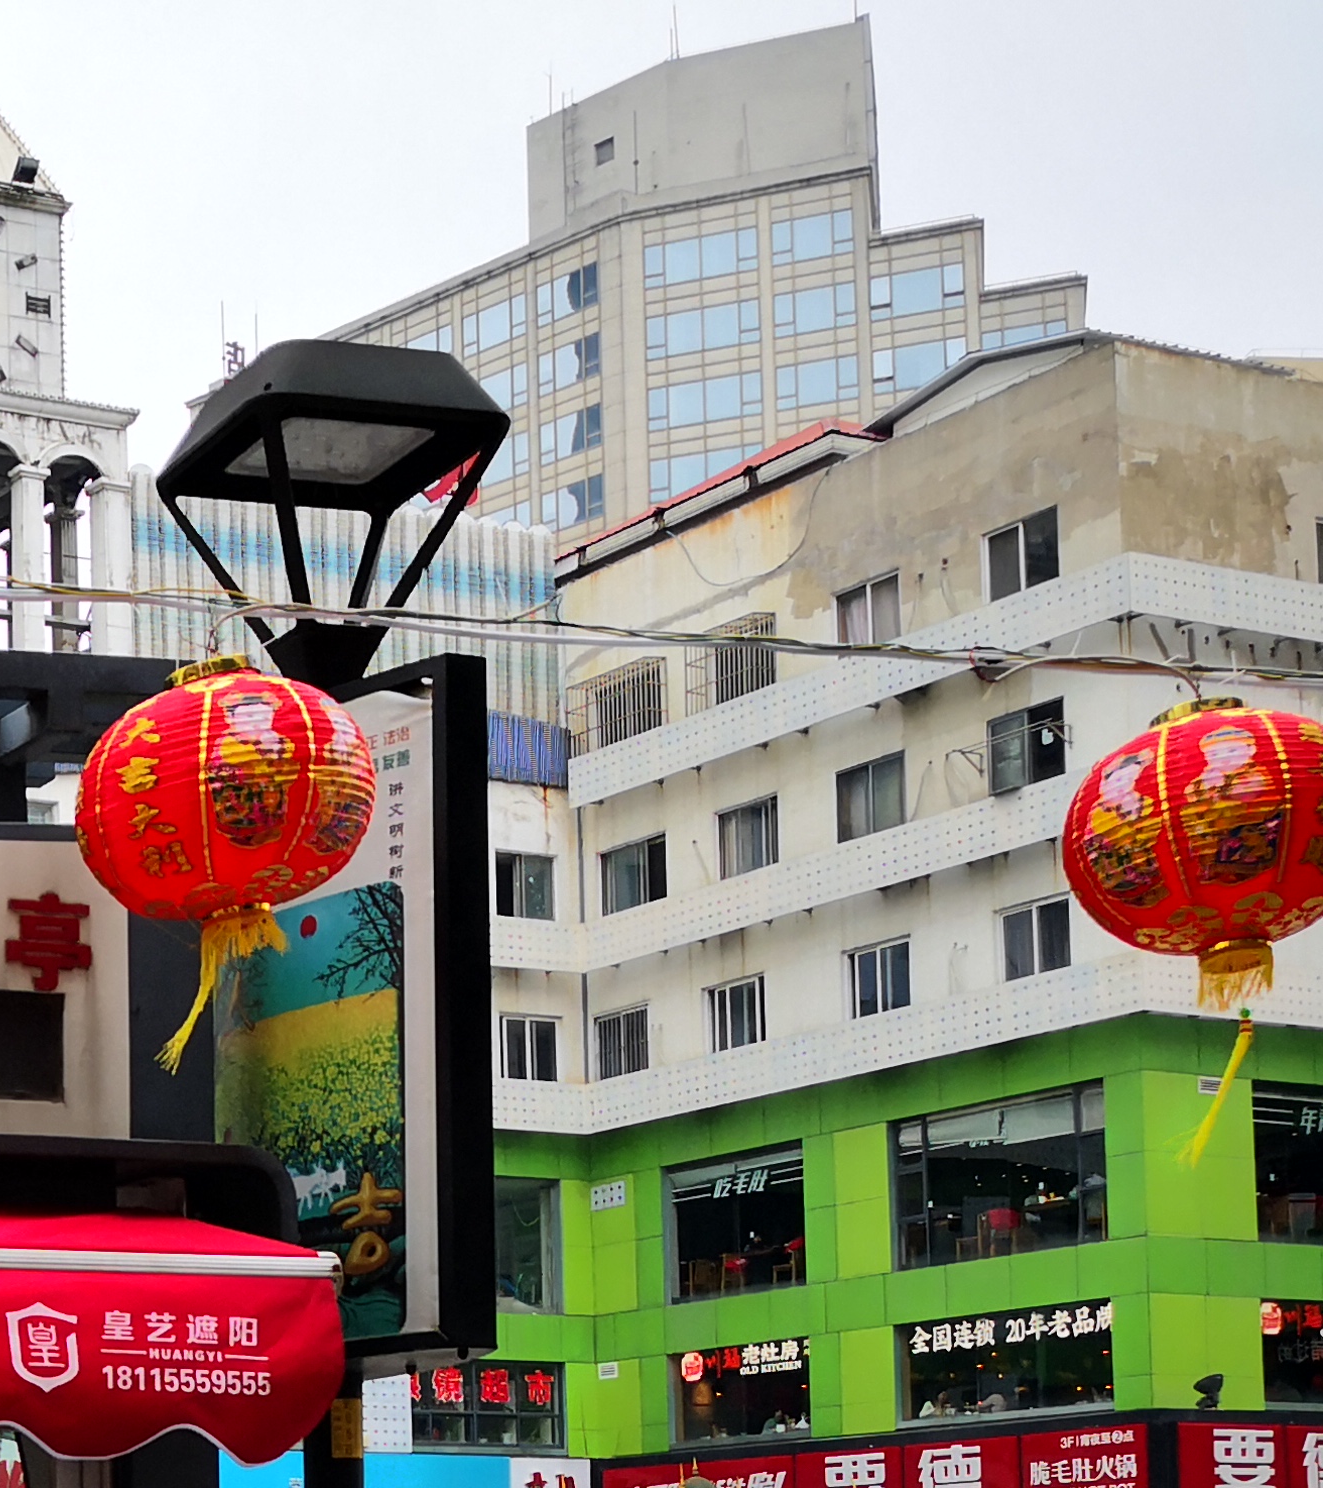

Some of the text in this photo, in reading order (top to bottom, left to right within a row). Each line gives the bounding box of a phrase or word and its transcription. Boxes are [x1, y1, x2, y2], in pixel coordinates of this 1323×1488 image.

[713, 1168, 769, 1198] 吃毛肚
[101, 1310, 259, 1348] 皇艺遮阳
[909, 1319, 995, 1354] 全国连锁
[149, 1347, 224, 1363] HUANGYI
[739, 1360, 802, 1376] OLD KITCHEN
[101, 1365, 272, 1397] 18115559555
[1029, 1453, 1138, 1487] 脆毛肚火锅
